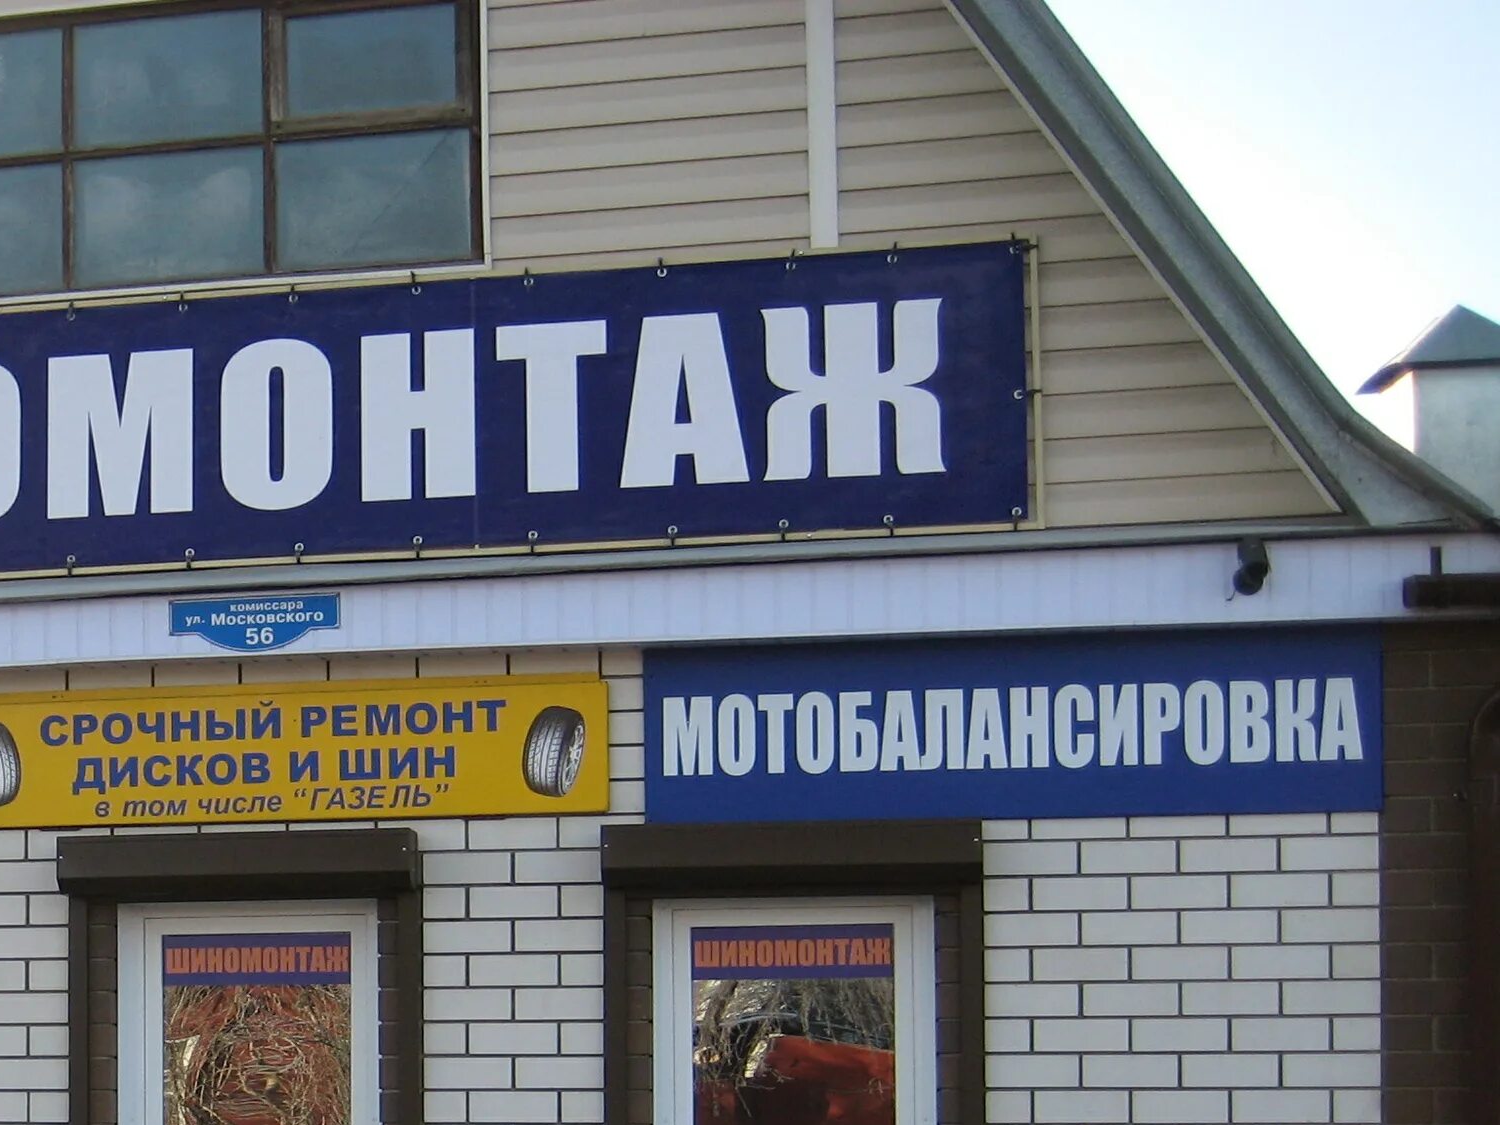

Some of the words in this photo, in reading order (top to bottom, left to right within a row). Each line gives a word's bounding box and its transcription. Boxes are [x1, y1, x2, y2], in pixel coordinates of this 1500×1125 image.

[184, 614, 206, 627] ул.
[210, 609, 325, 627] Московского
[229, 599, 304, 613] комиссара
[245, 627, 275, 646] 56
[38, 700, 282, 748] СРОЧНЫЙ
[299, 699, 507, 739] РЕМОНТ
[661, 676, 1365, 777] МОТОБАЛАНСИРОВКА
[72, 751, 271, 795] ДИСКОВ
[289, 750, 319, 783] И
[338, 745, 456, 781] ШИН
[94, 799, 110, 818] в
[122, 797, 187, 818] том
[197, 794, 283, 815] числе
[165, 945, 349, 975] ШИНОМОНТАЖ
[694, 937, 891, 968] ШИНОМОНТАЖ
